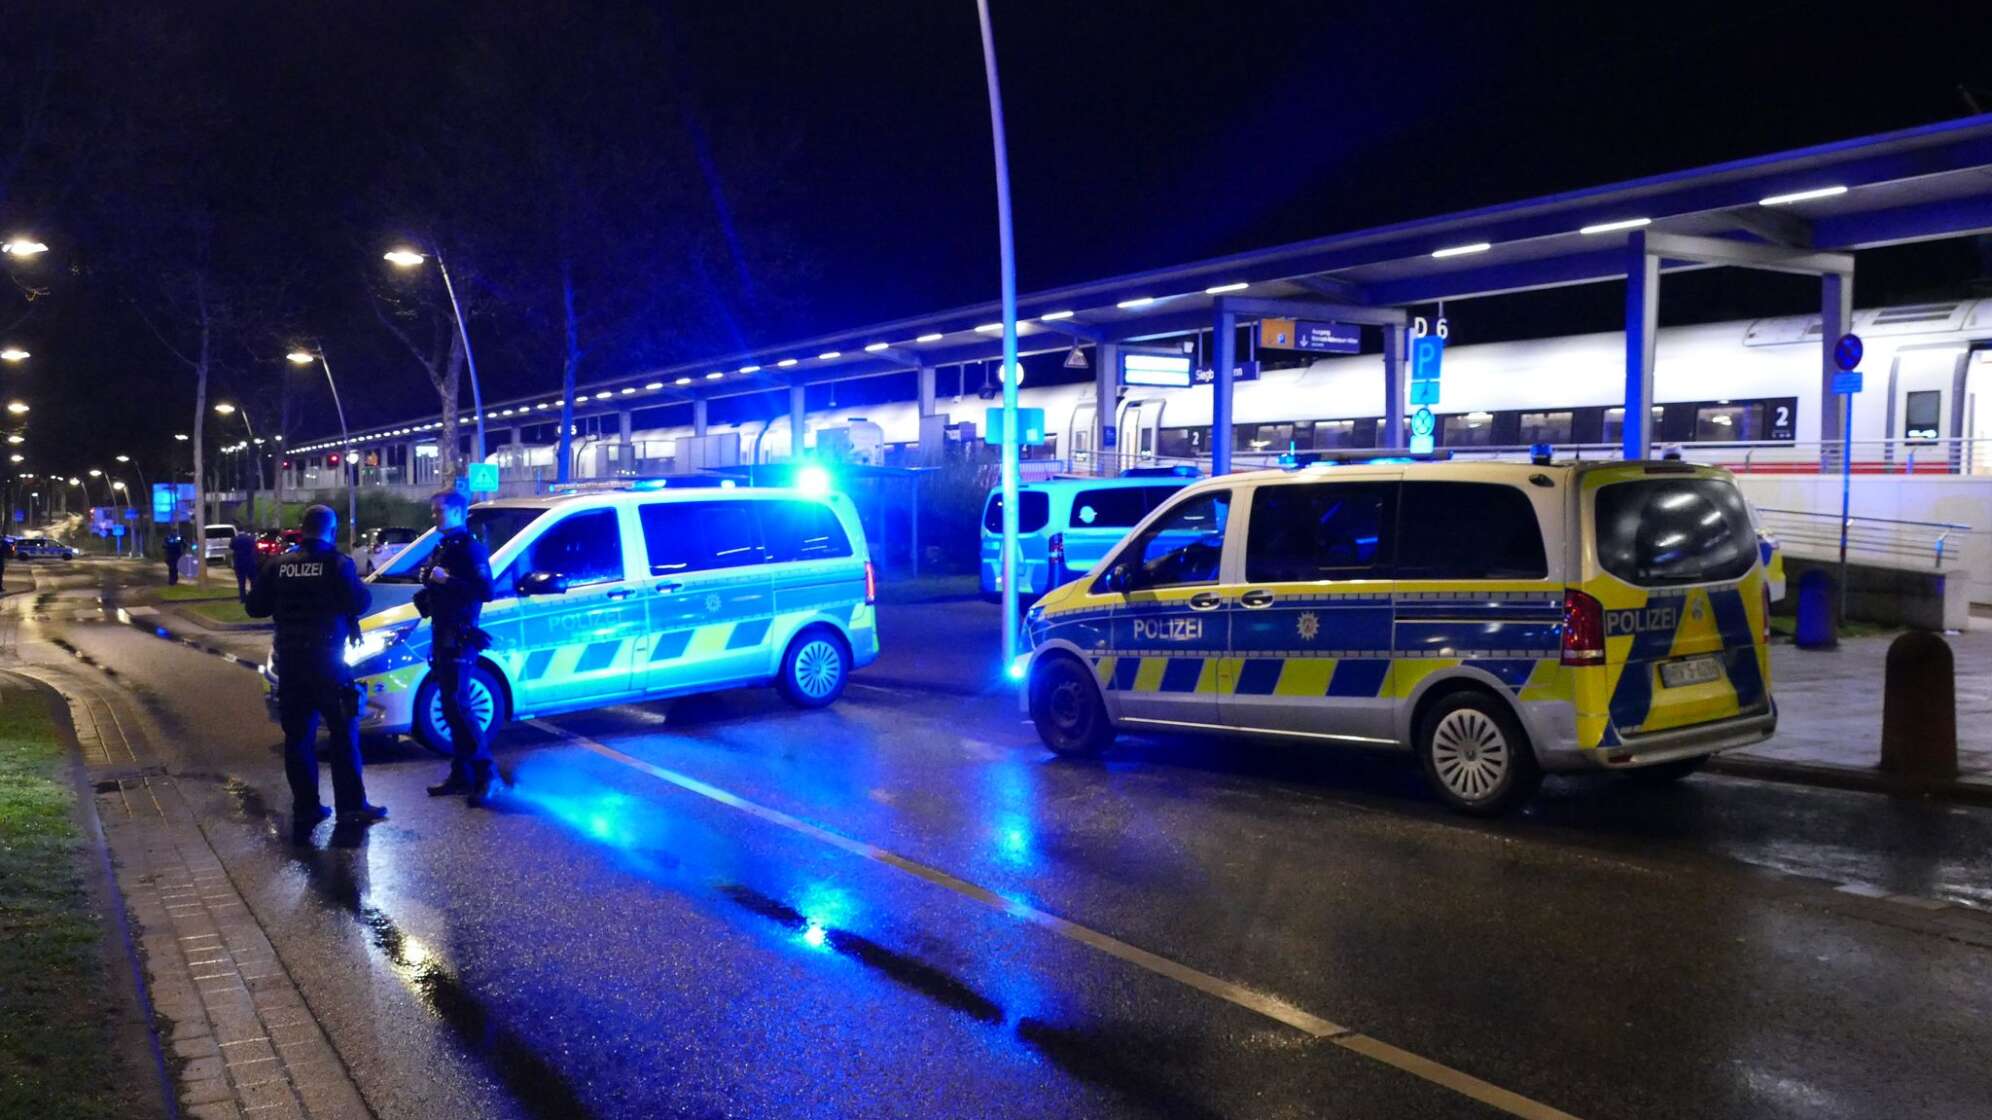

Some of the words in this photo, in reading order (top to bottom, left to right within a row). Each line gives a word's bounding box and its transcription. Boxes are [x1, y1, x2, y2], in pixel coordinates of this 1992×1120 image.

[1414, 316, 1428, 338] D
[1436, 318, 1448, 340] 6
[1418, 342, 1435, 375] P
[1775, 406, 1789, 427] 2
[1192, 431, 1200, 446] 2
[279, 561, 323, 577] POLIZEI
[1133, 618, 1203, 641] POLIZEI
[1606, 607, 1677, 634] POLIZEI
